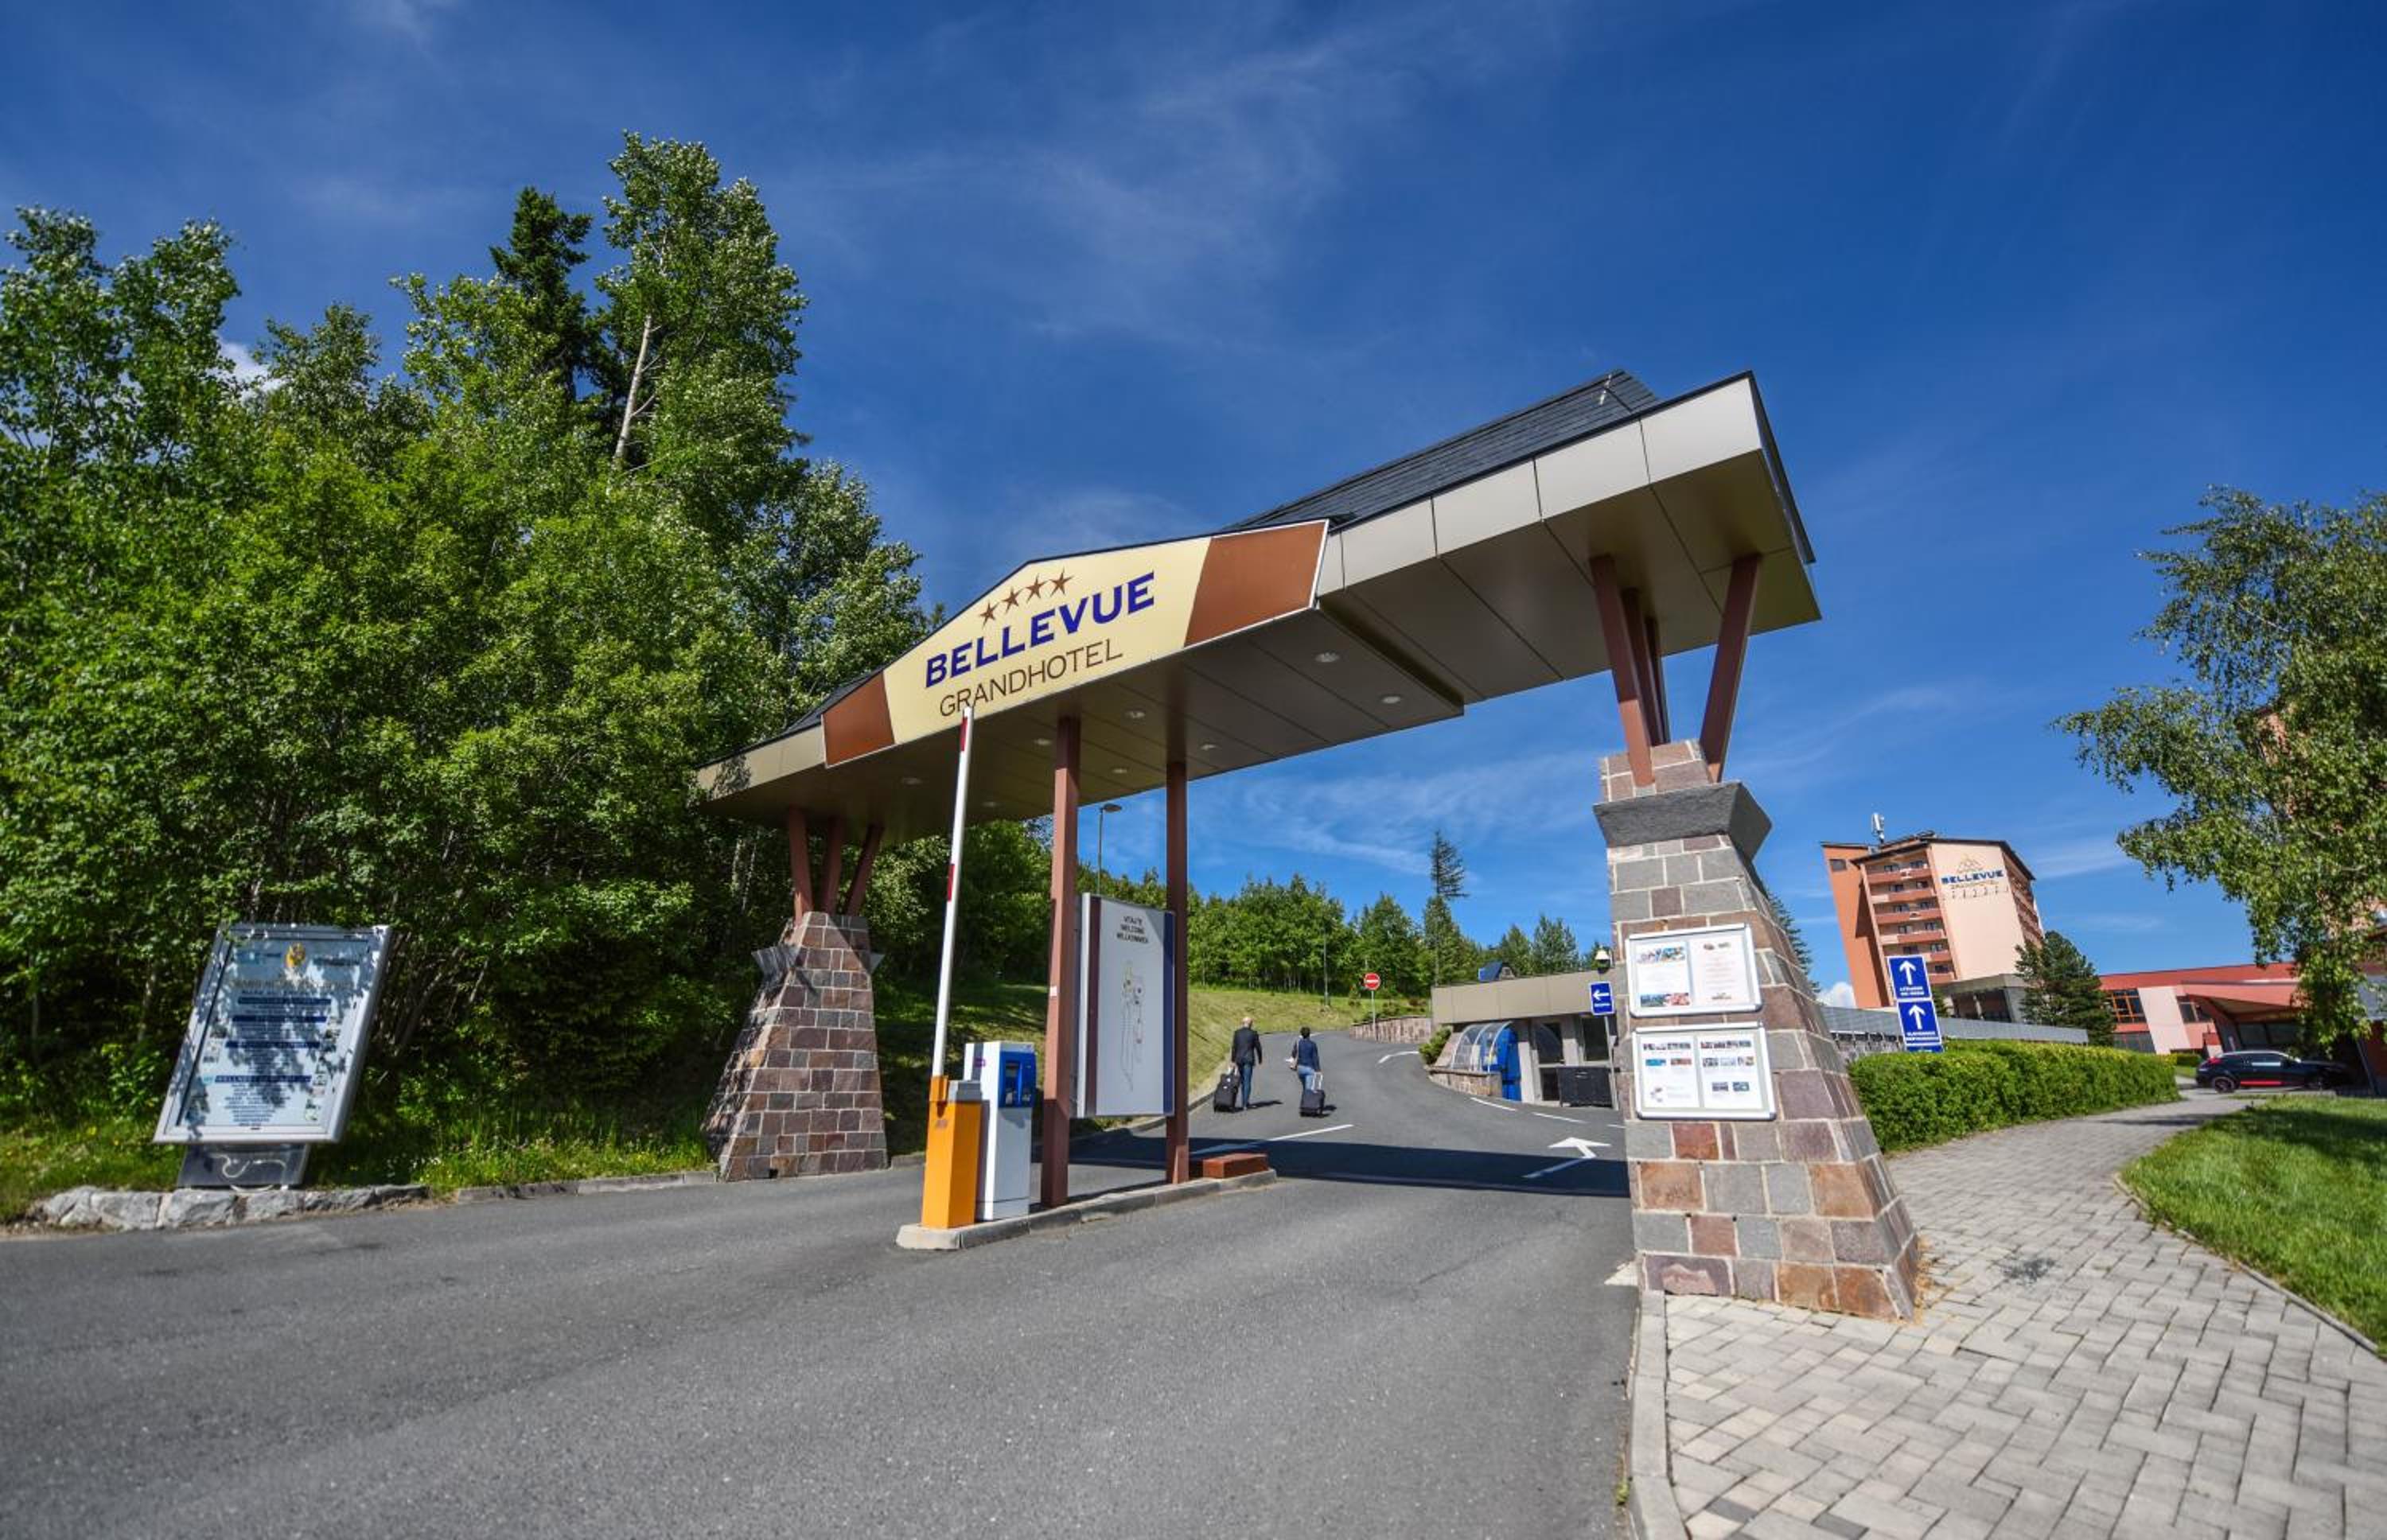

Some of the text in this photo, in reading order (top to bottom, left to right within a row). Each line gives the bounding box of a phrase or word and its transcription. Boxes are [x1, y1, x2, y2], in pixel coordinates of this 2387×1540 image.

[925, 570, 1155, 688] BELLEVUE
[940, 639, 1123, 717] GRANDHOTEL
[1941, 869, 2003, 885] BELLEVUE
